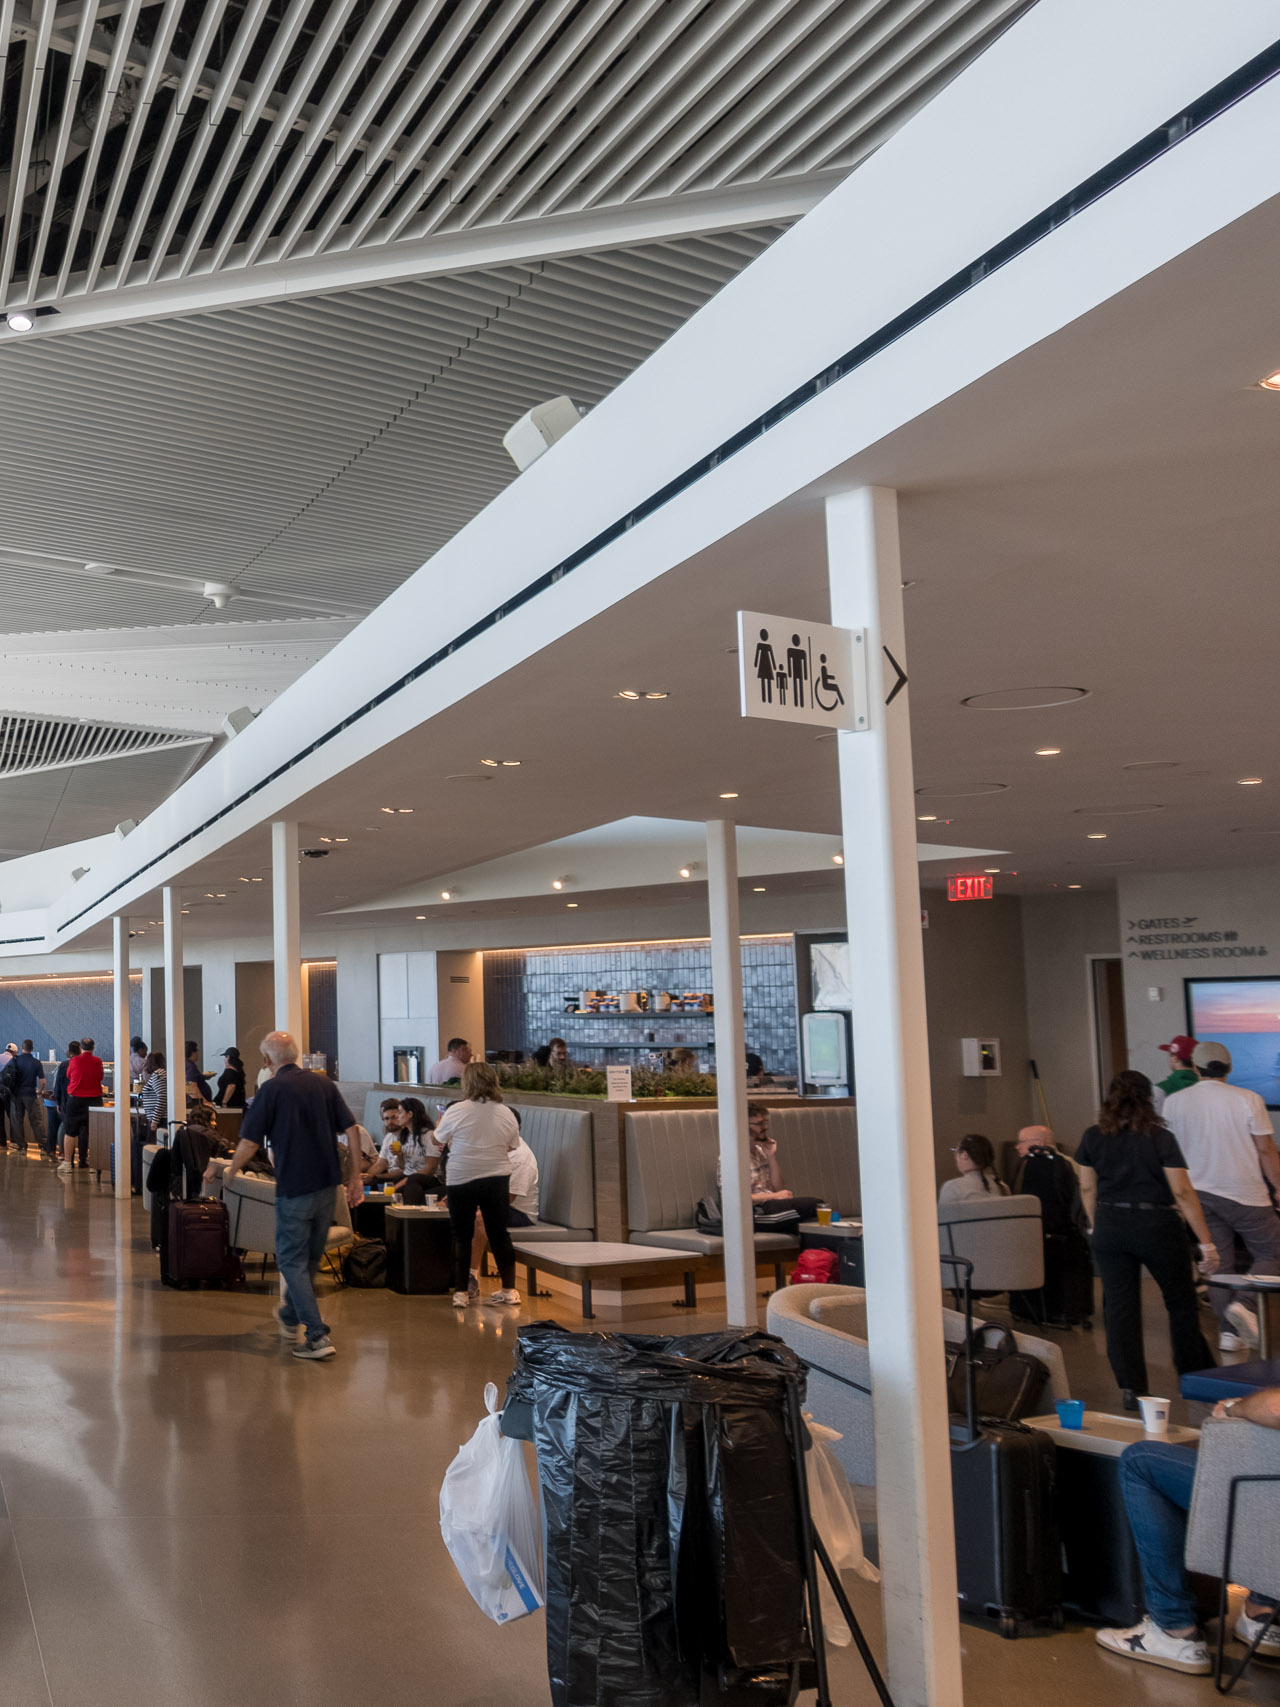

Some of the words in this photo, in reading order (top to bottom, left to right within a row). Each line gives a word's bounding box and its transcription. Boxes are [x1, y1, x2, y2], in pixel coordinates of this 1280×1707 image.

[955, 877, 986, 898] EXIT
[1138, 917, 1180, 930] GATES
[1138, 931, 1222, 945] RESTROOMS
[1140, 948, 1210, 960] WELLNESS
[1212, 946, 1257, 958] ROOM
